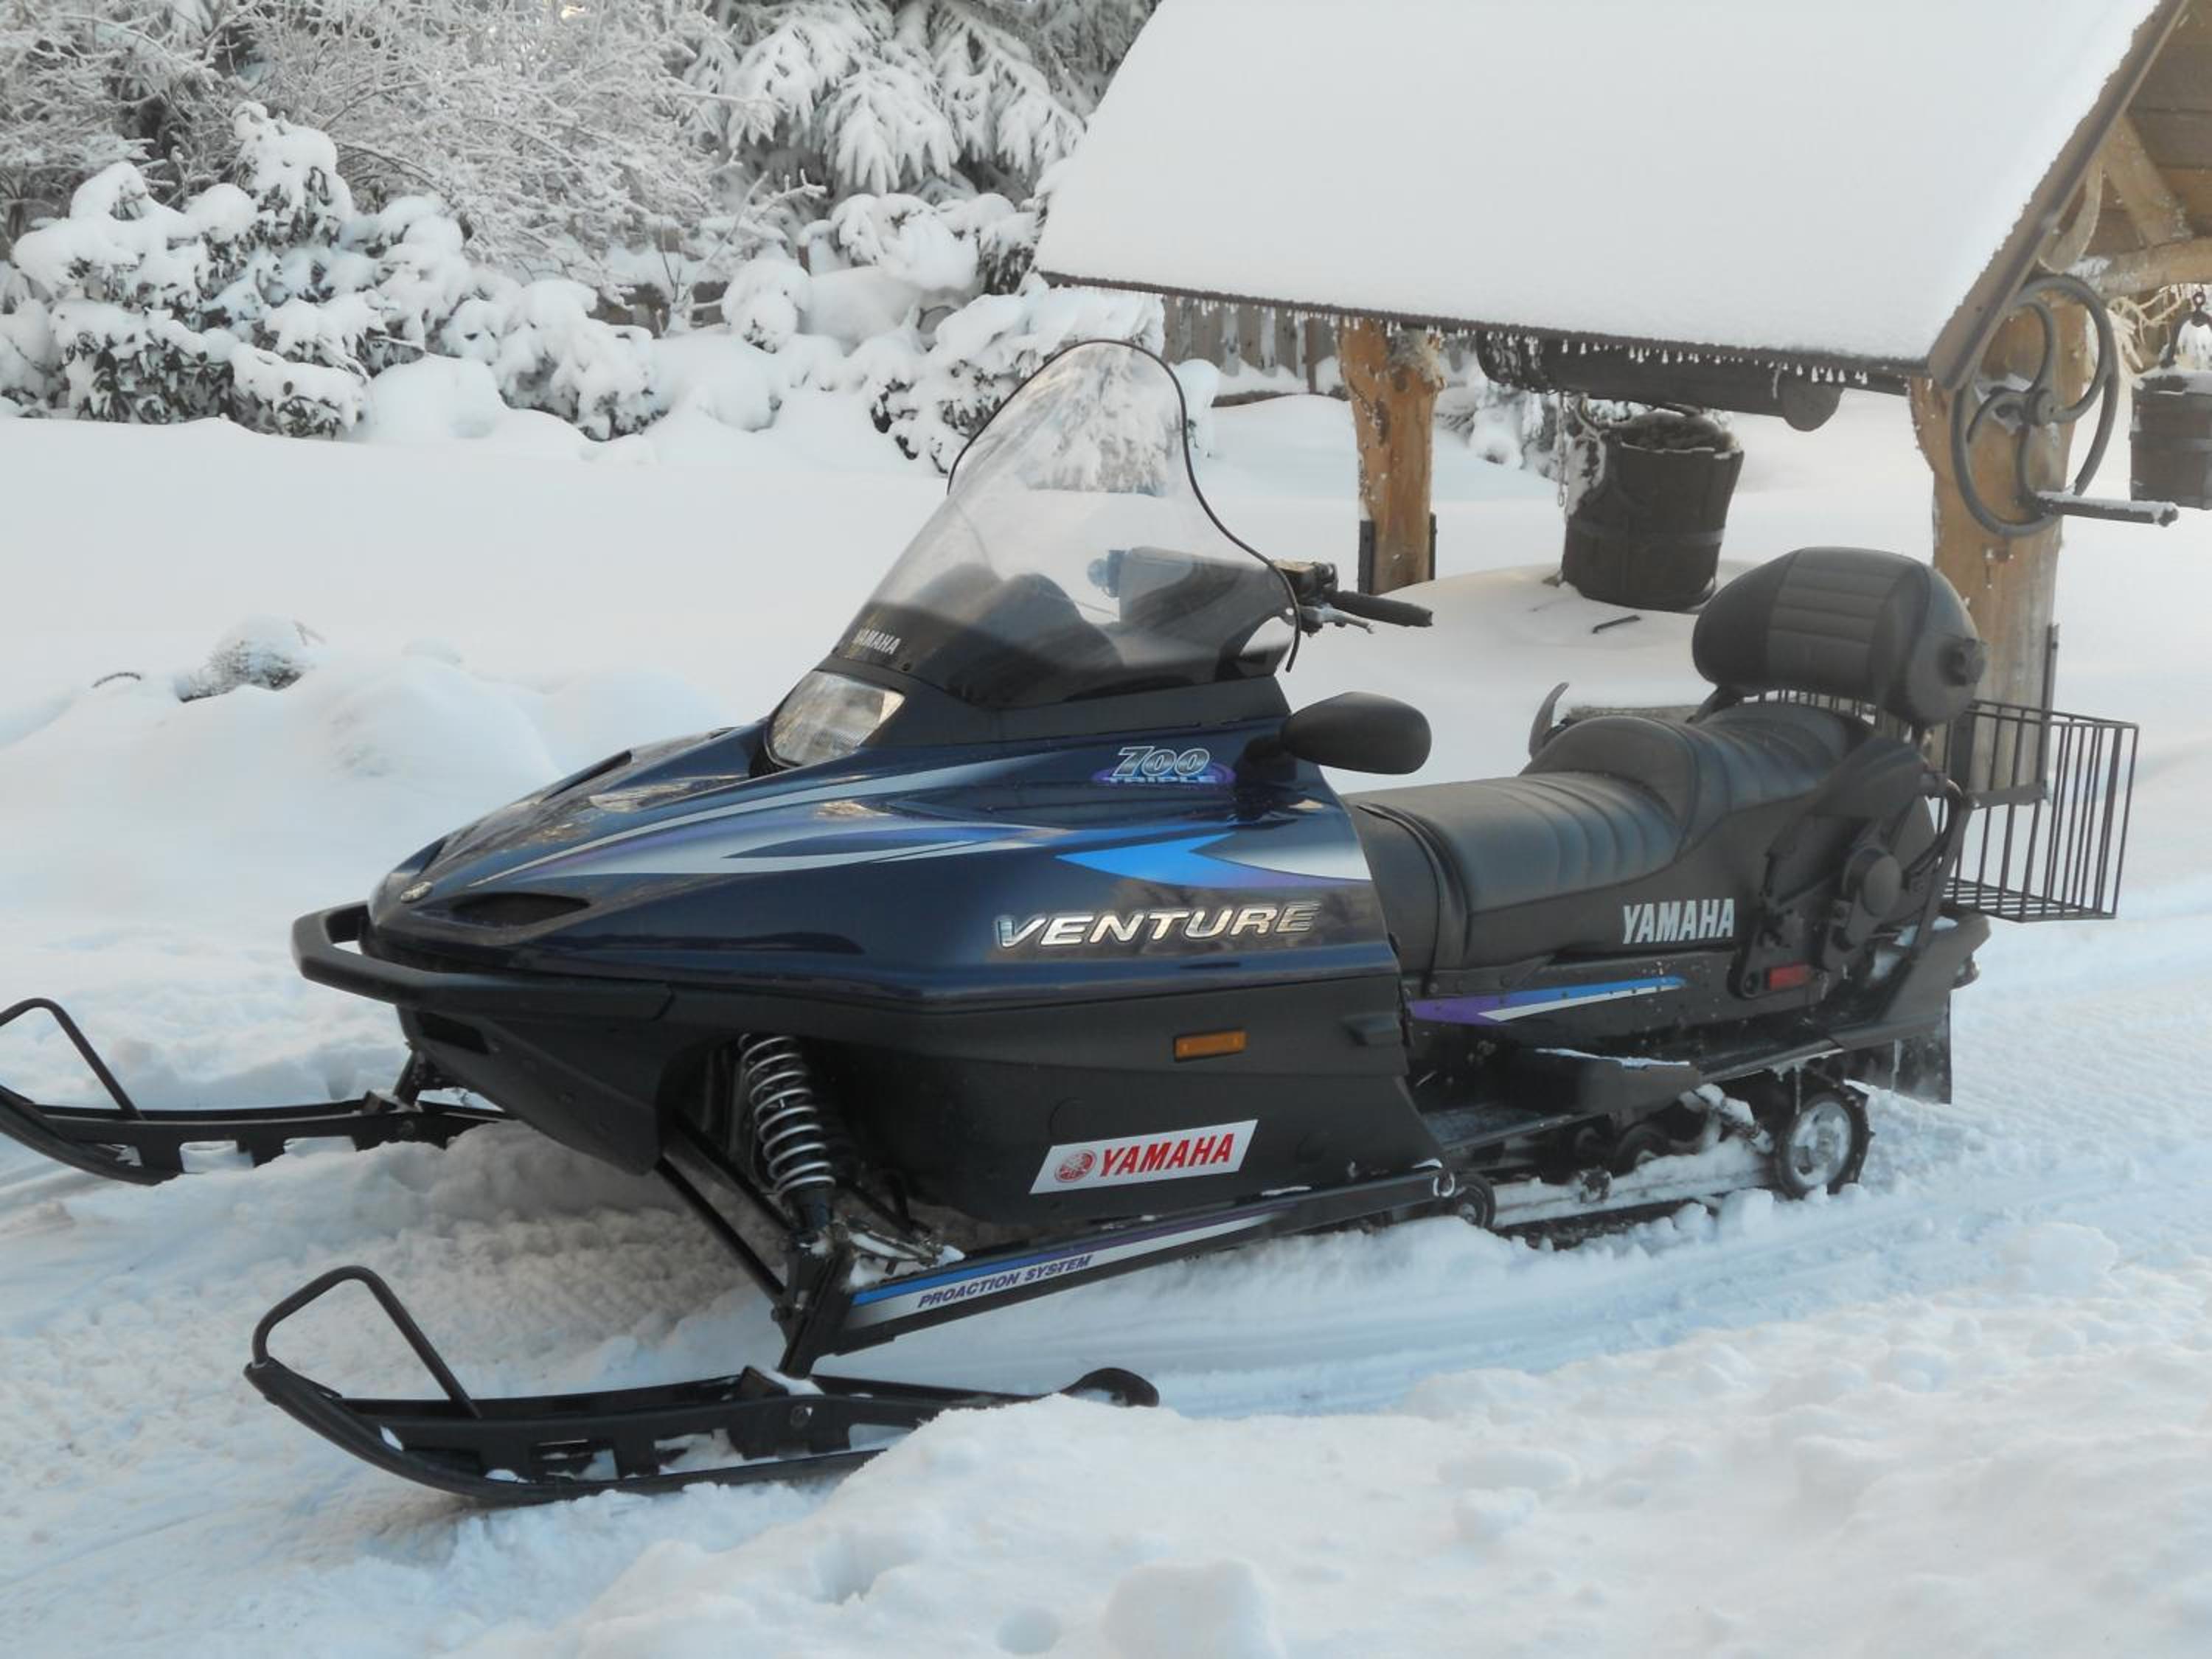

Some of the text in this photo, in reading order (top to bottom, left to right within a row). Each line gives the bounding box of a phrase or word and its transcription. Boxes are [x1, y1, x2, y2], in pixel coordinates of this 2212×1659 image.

[1112, 745, 1210, 776] 700
[997, 902, 1321, 947] VENTURE
[1623, 898, 1735, 945] YAMAHA
[1099, 1133, 1234, 1177] YAMAHA
[918, 1255, 1093, 1308] PROACTION SYSTEM
